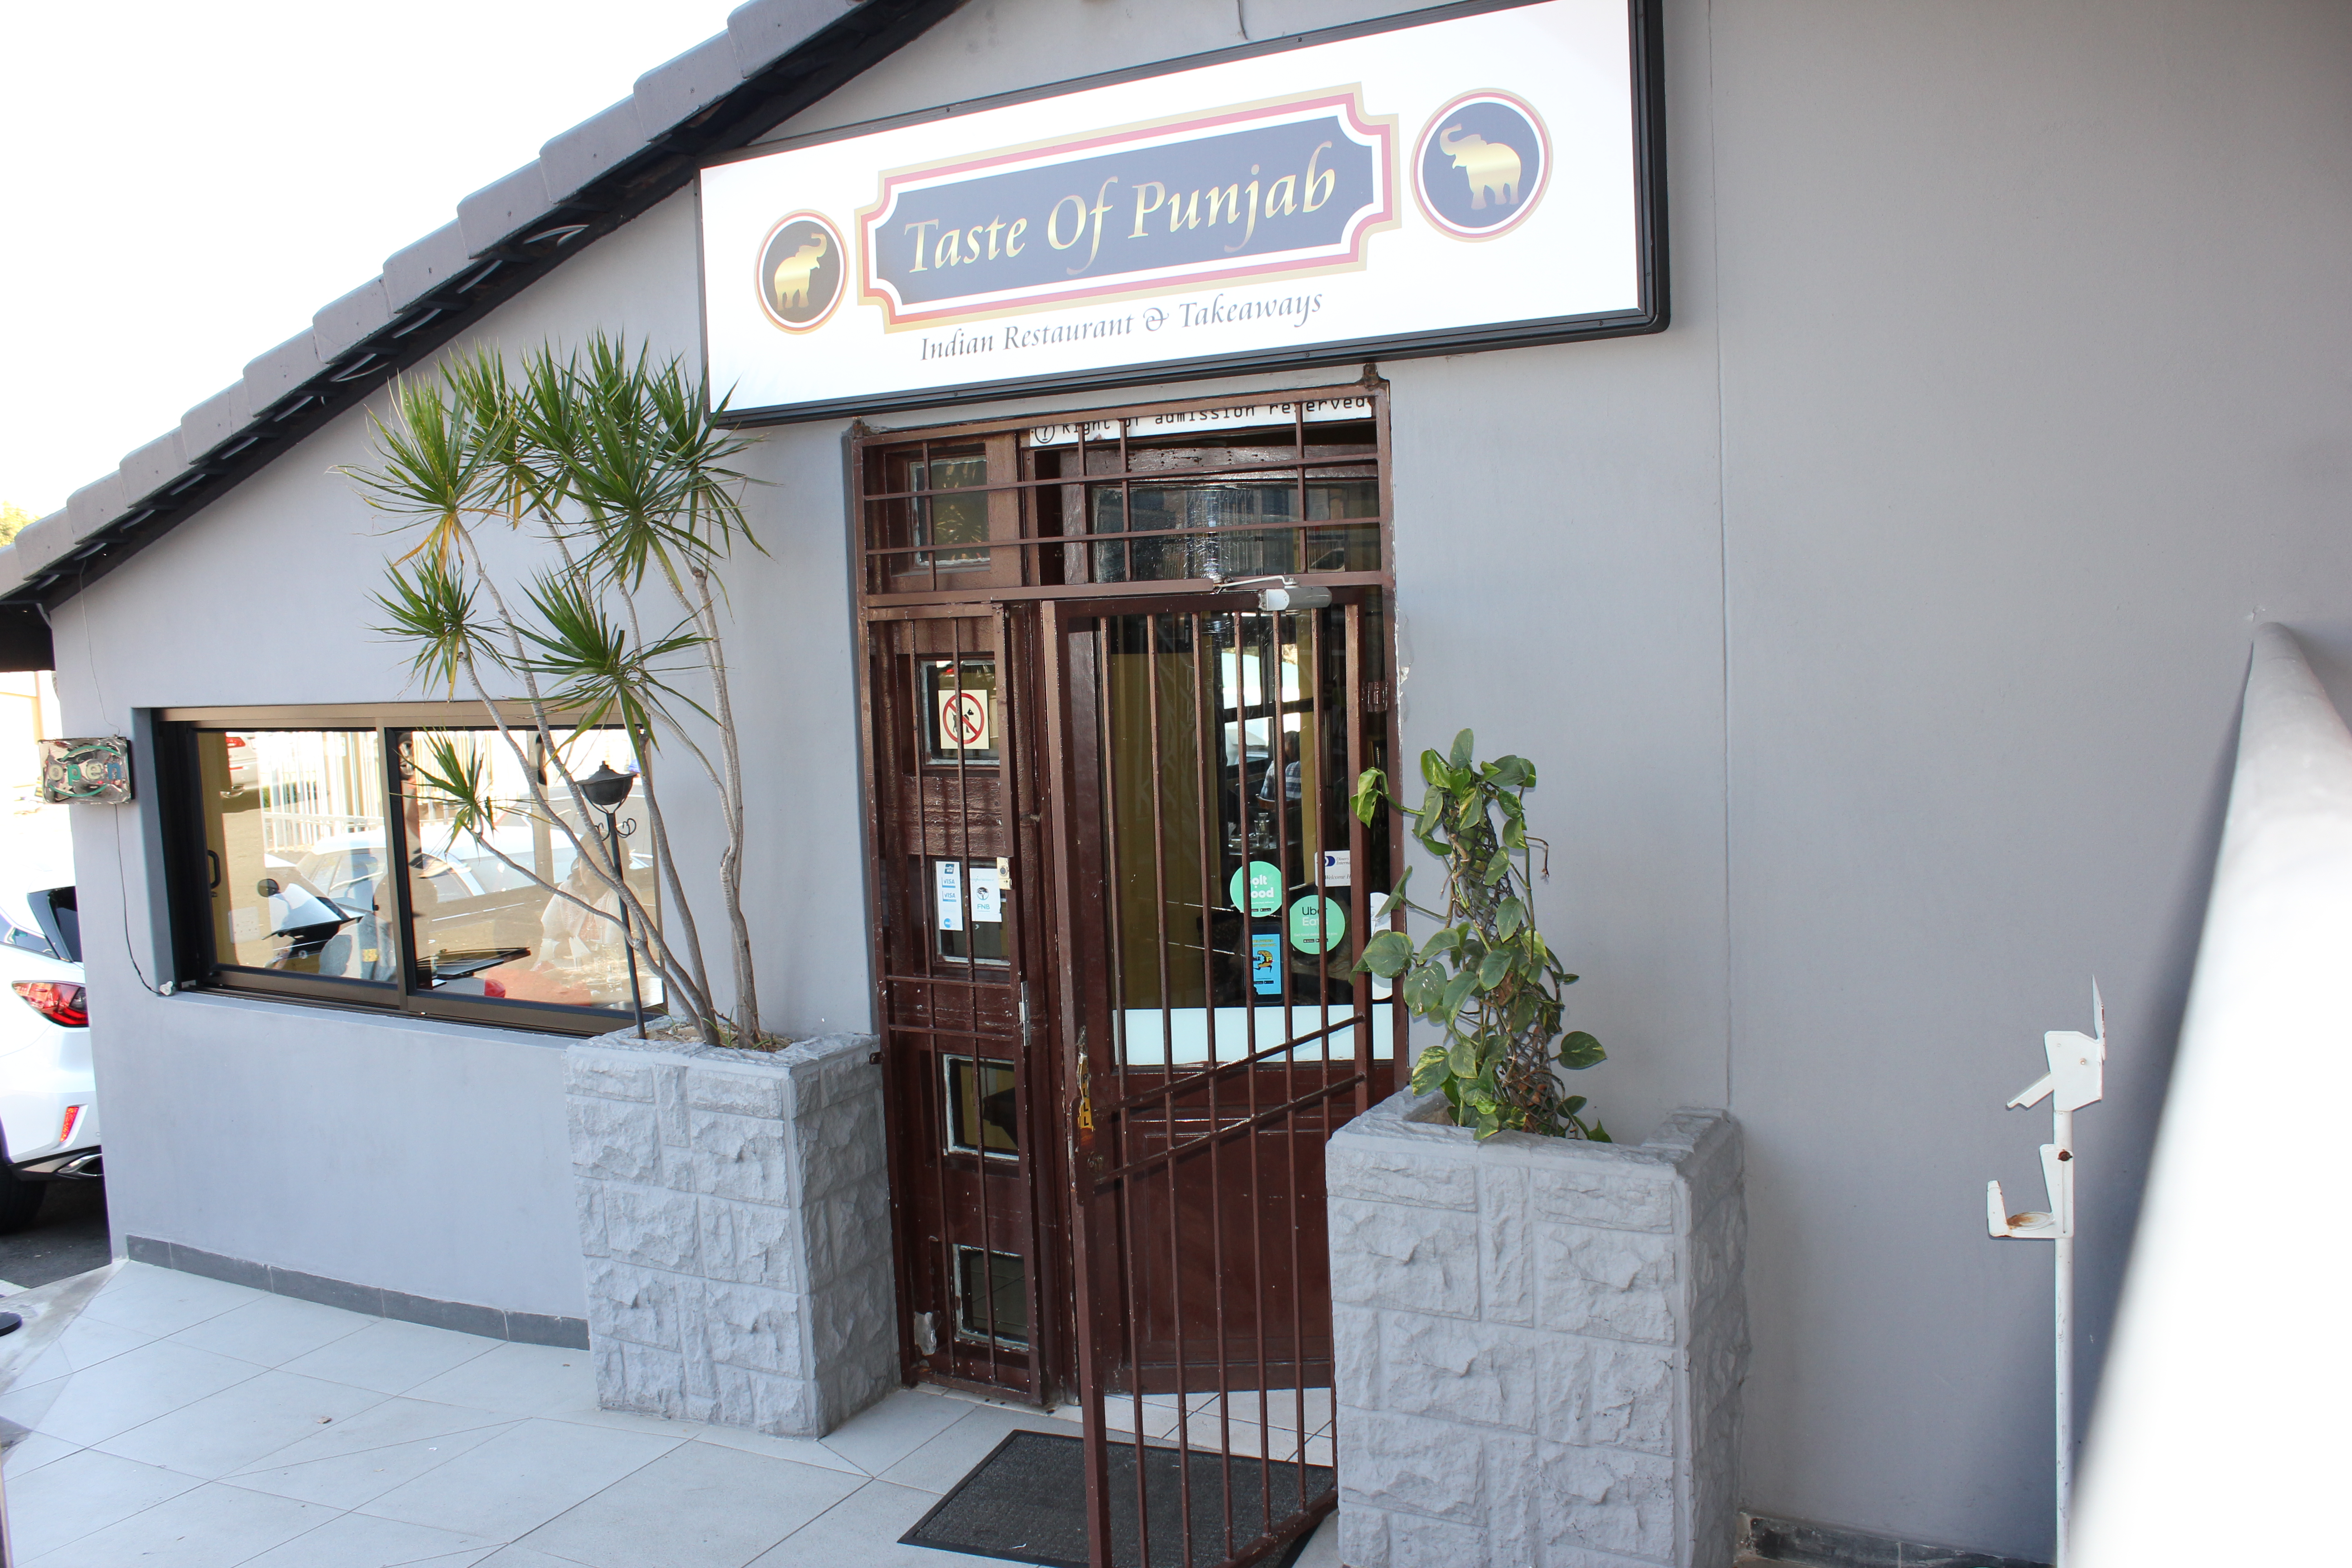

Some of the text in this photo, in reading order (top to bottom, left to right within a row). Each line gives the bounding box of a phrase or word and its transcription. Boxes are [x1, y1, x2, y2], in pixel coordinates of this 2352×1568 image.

[904, 141, 1336, 275] Taste Of Punjab
[920, 293, 1323, 361] Indian Restaurant & Takeaways
[1269, 397, 1366, 415] reerved
[48, 762, 122, 785] open
[1250, 874, 1268, 886] olt
[1250, 887, 1274, 899] ood
[1302, 906, 1328, 916] Ub
